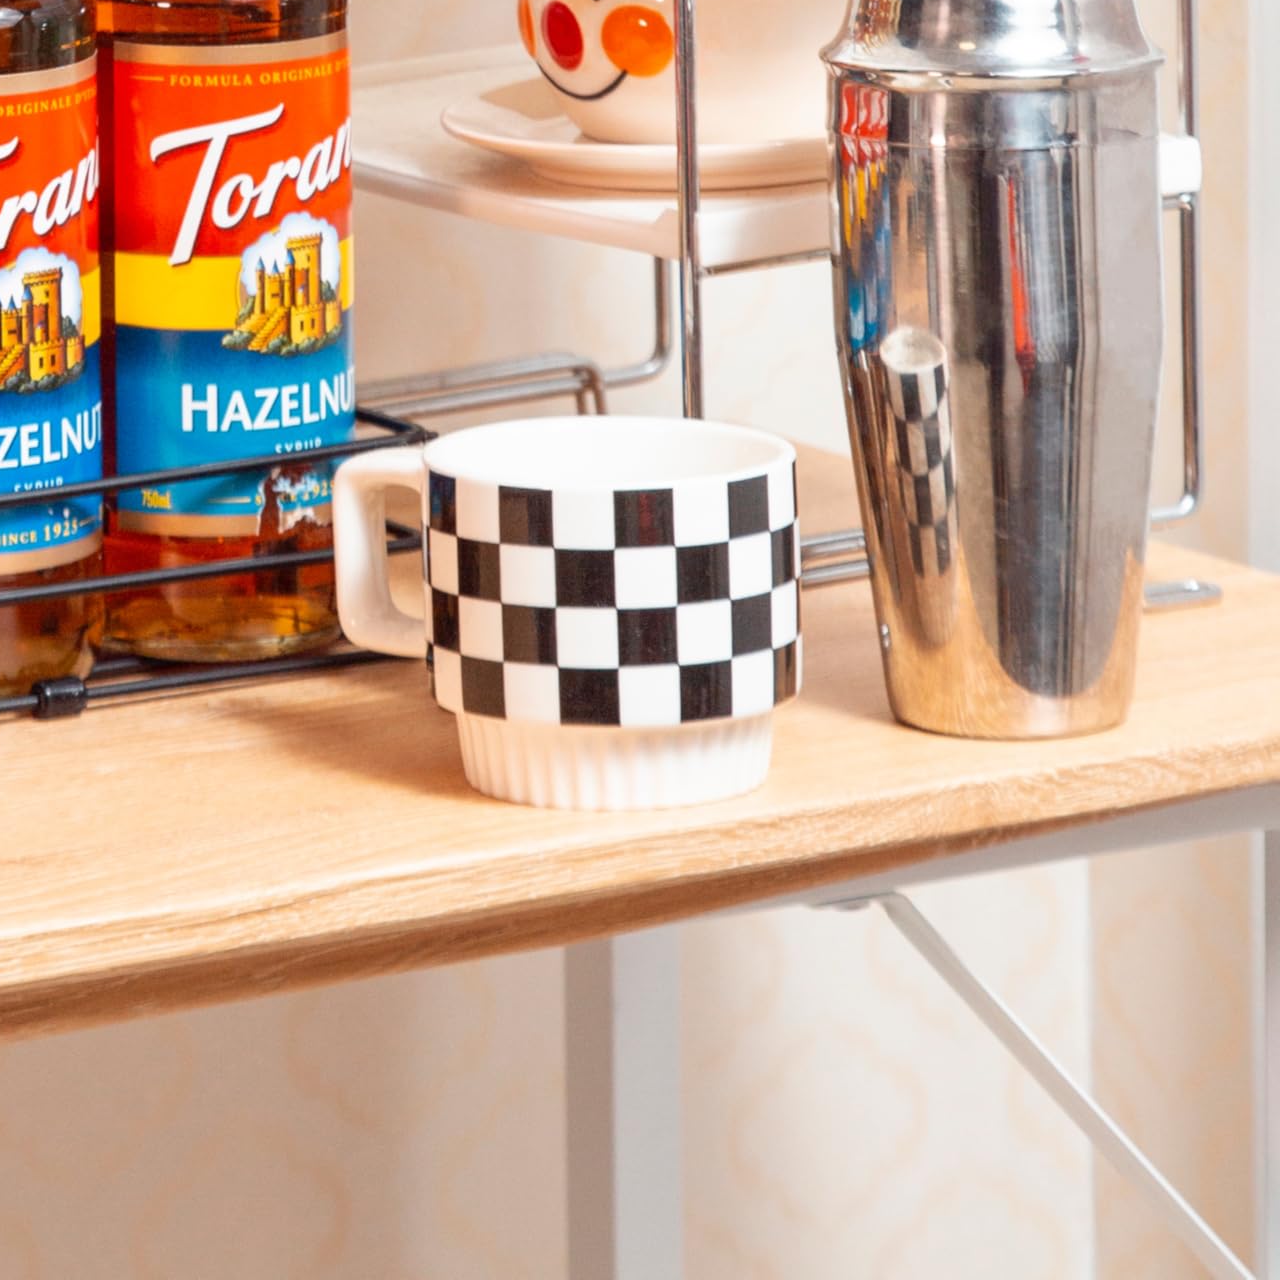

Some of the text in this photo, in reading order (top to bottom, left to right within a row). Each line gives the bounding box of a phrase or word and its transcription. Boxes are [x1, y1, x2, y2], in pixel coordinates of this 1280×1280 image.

[170, 74, 253, 86] FORMULA
[259, 63, 333, 84] ORIGINALE
[149, 102, 353, 267] Toran
